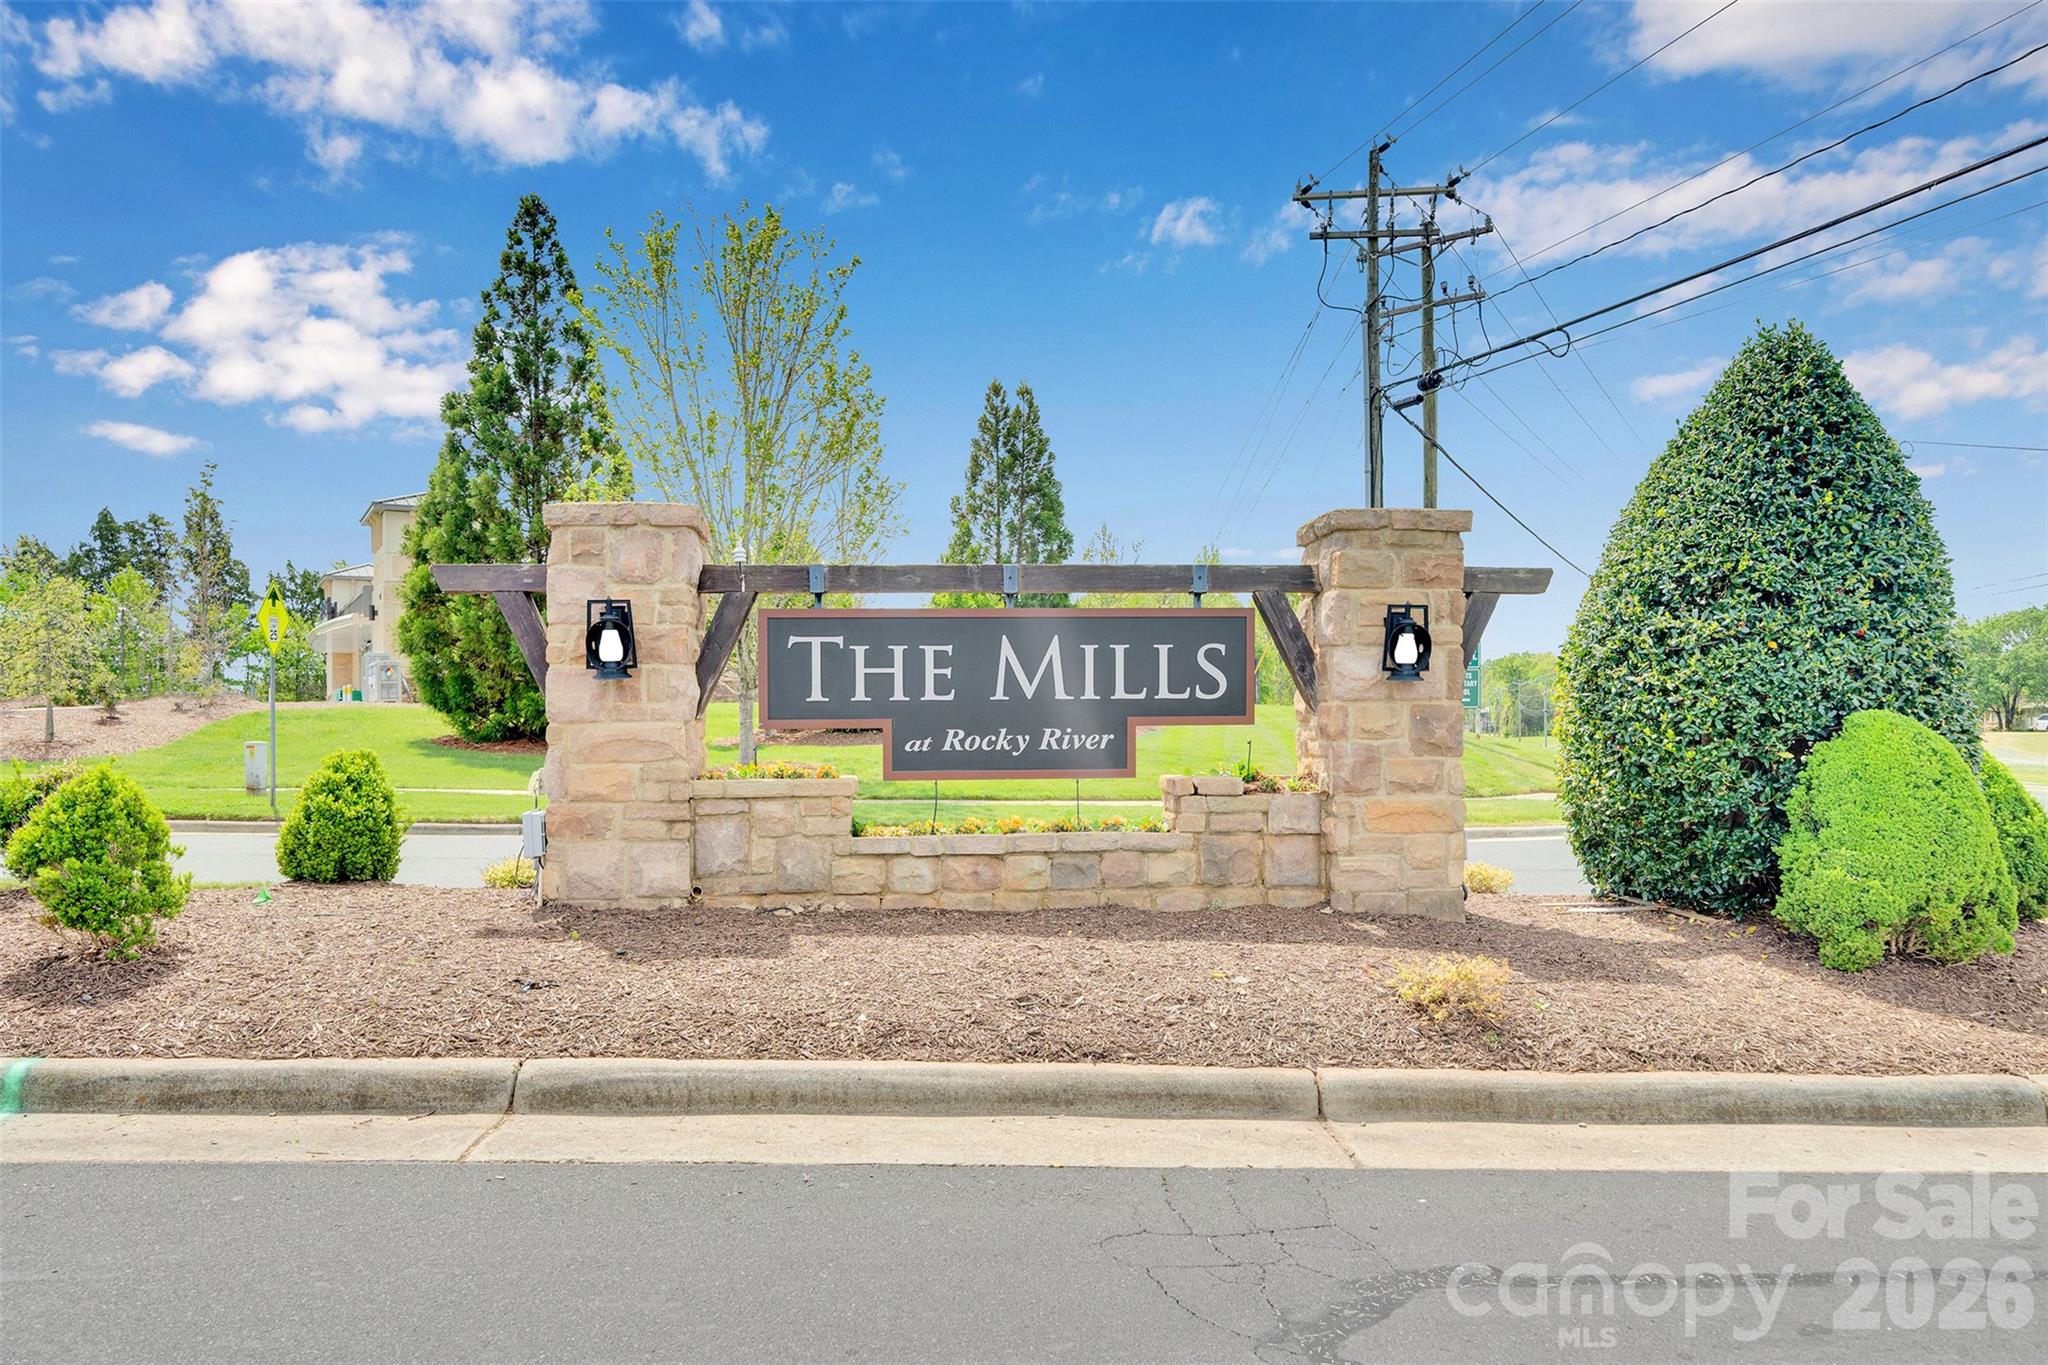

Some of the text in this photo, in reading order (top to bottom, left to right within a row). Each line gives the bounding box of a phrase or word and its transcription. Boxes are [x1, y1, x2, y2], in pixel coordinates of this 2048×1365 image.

[787, 634, 1229, 702] THE MILLS
[904, 727, 1115, 756] at Rocky River
